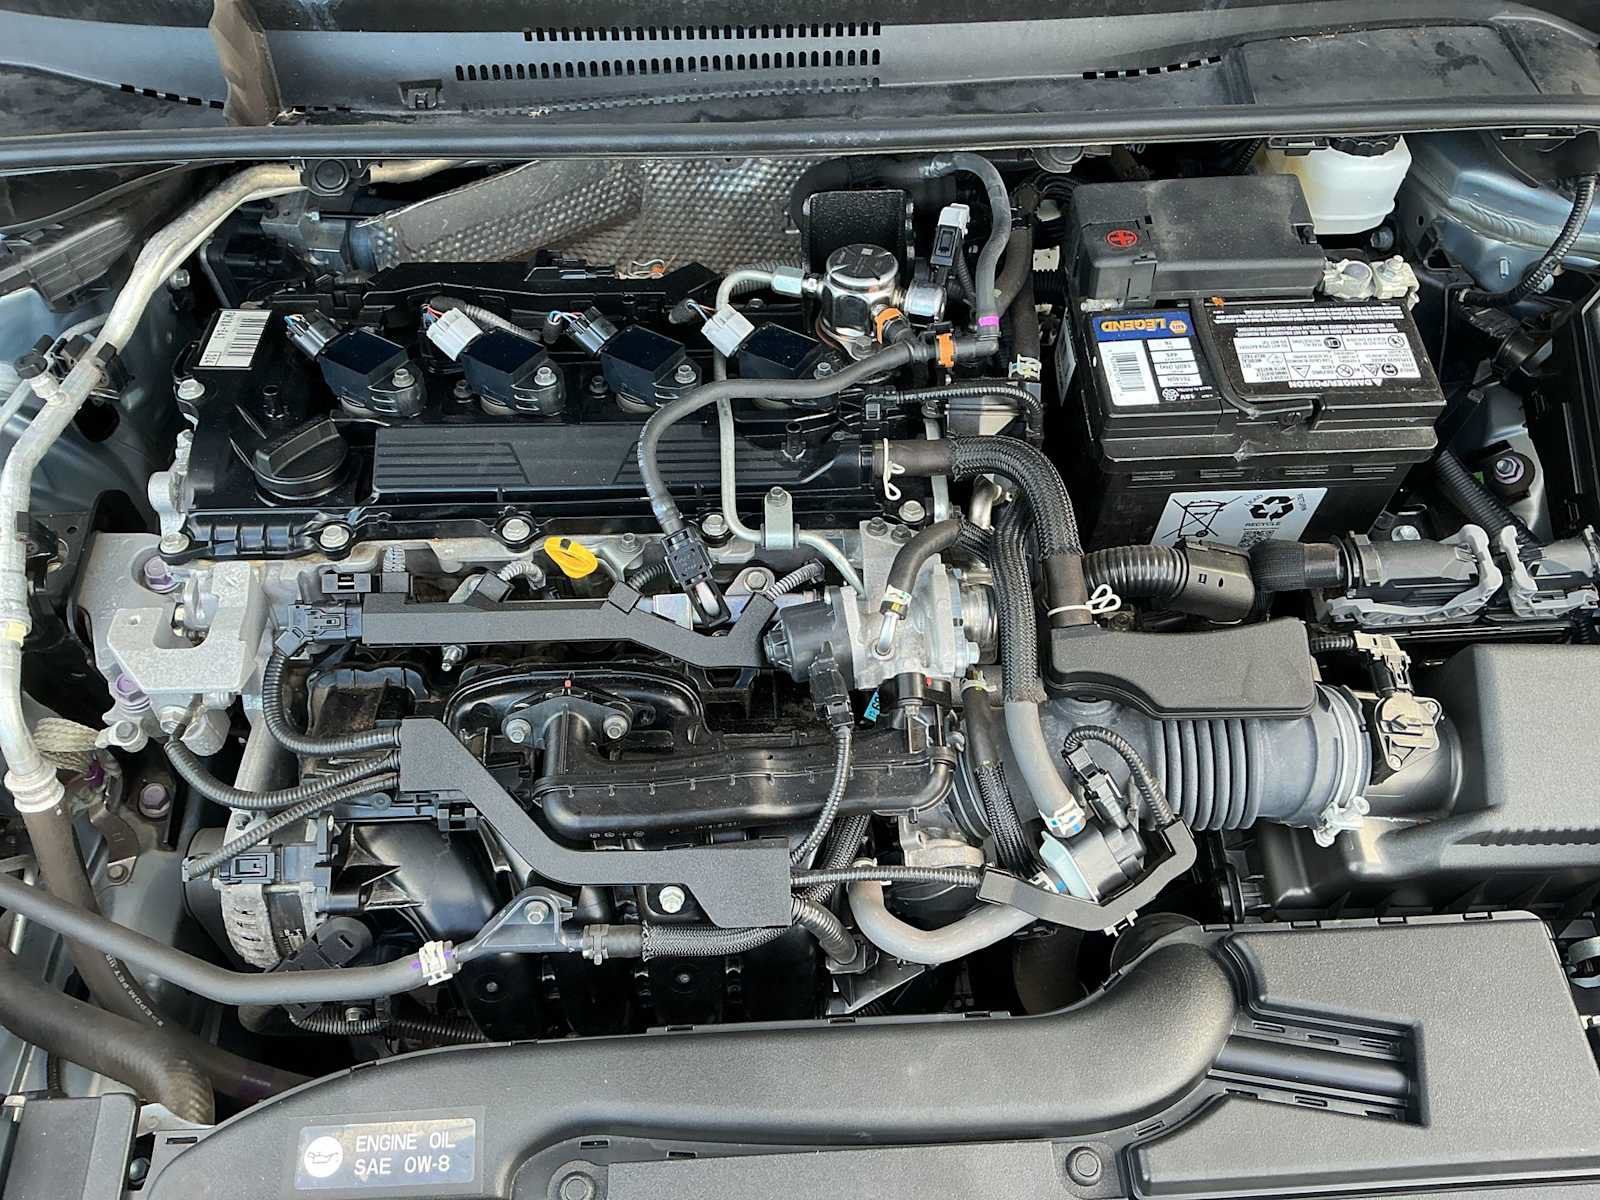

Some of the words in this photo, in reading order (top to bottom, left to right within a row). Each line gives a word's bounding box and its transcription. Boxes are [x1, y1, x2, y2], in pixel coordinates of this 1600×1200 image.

[1101, 318, 1167, 332] LEGEND
[356, 1134, 418, 1152] ENGINE
[429, 1131, 456, 1148] OIL
[354, 1157, 392, 1176] SAE
